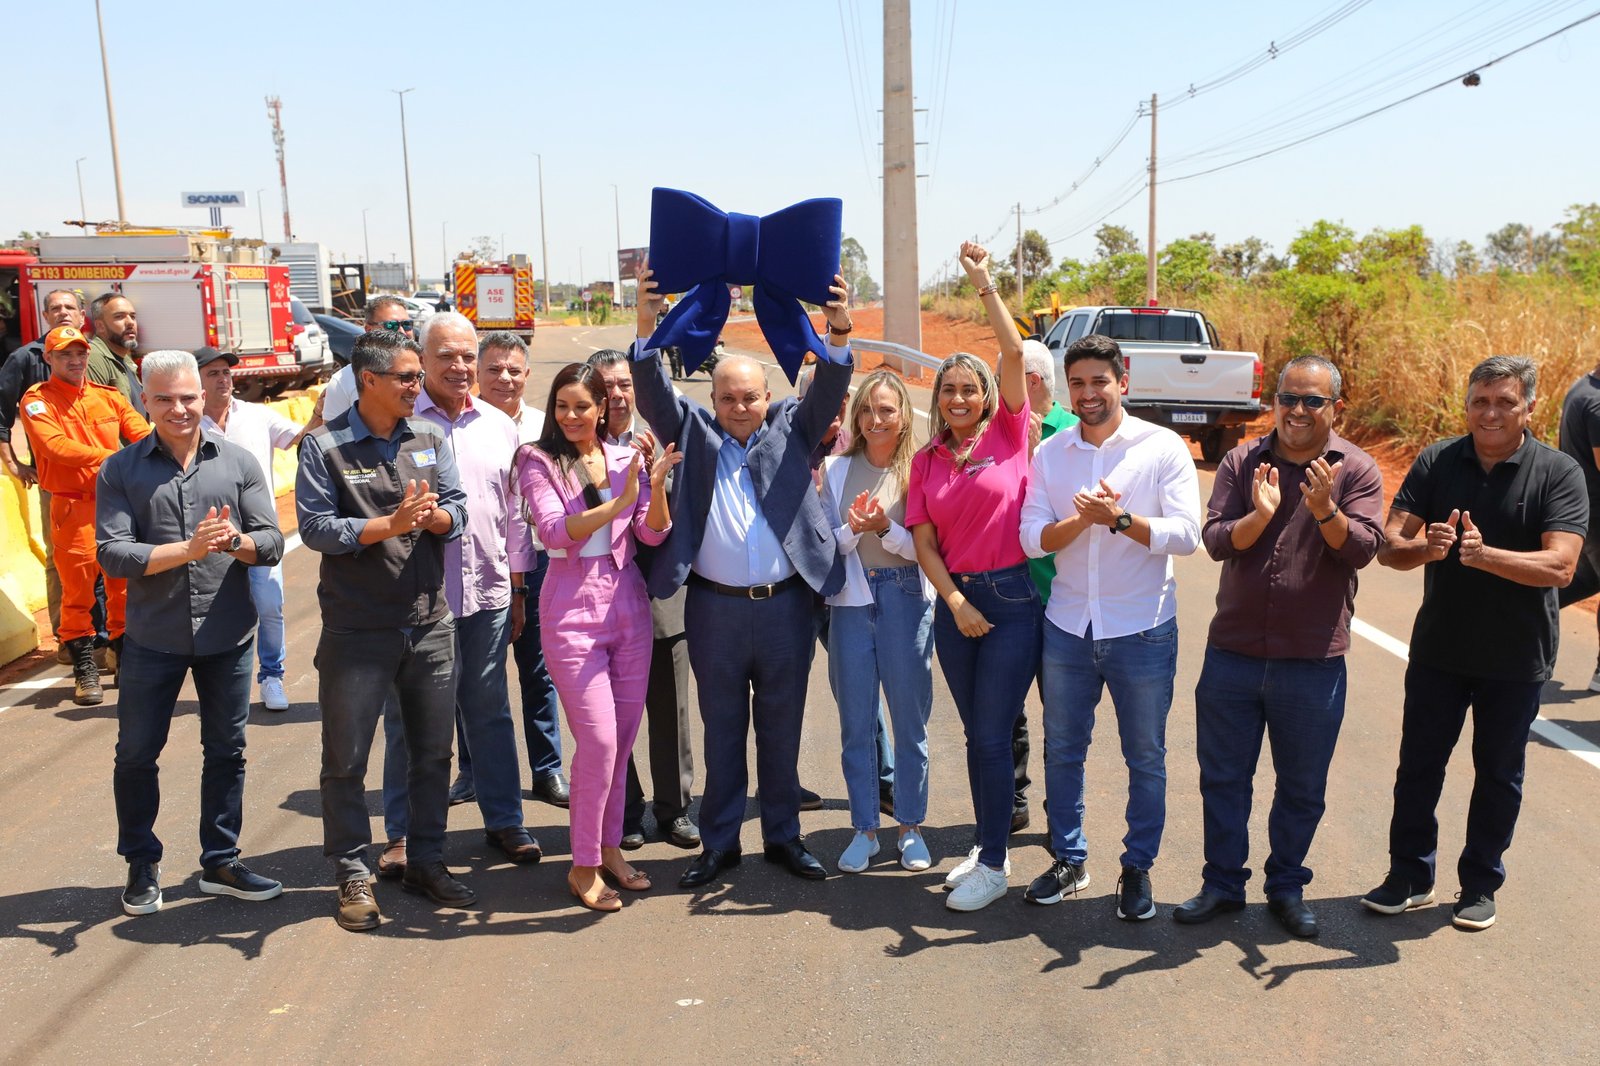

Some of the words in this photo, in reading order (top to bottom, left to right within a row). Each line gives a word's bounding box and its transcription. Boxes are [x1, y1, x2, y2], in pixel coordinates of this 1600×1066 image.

[187, 194, 239, 204] SCANIA
[42, 267, 60, 279] 193
[63, 266, 125, 279] BOMBEIROS
[229, 266, 266, 279] BOMBEIROS
[487, 288, 505, 296] ASE
[477, 320, 515, 328] BOMBEIROS
